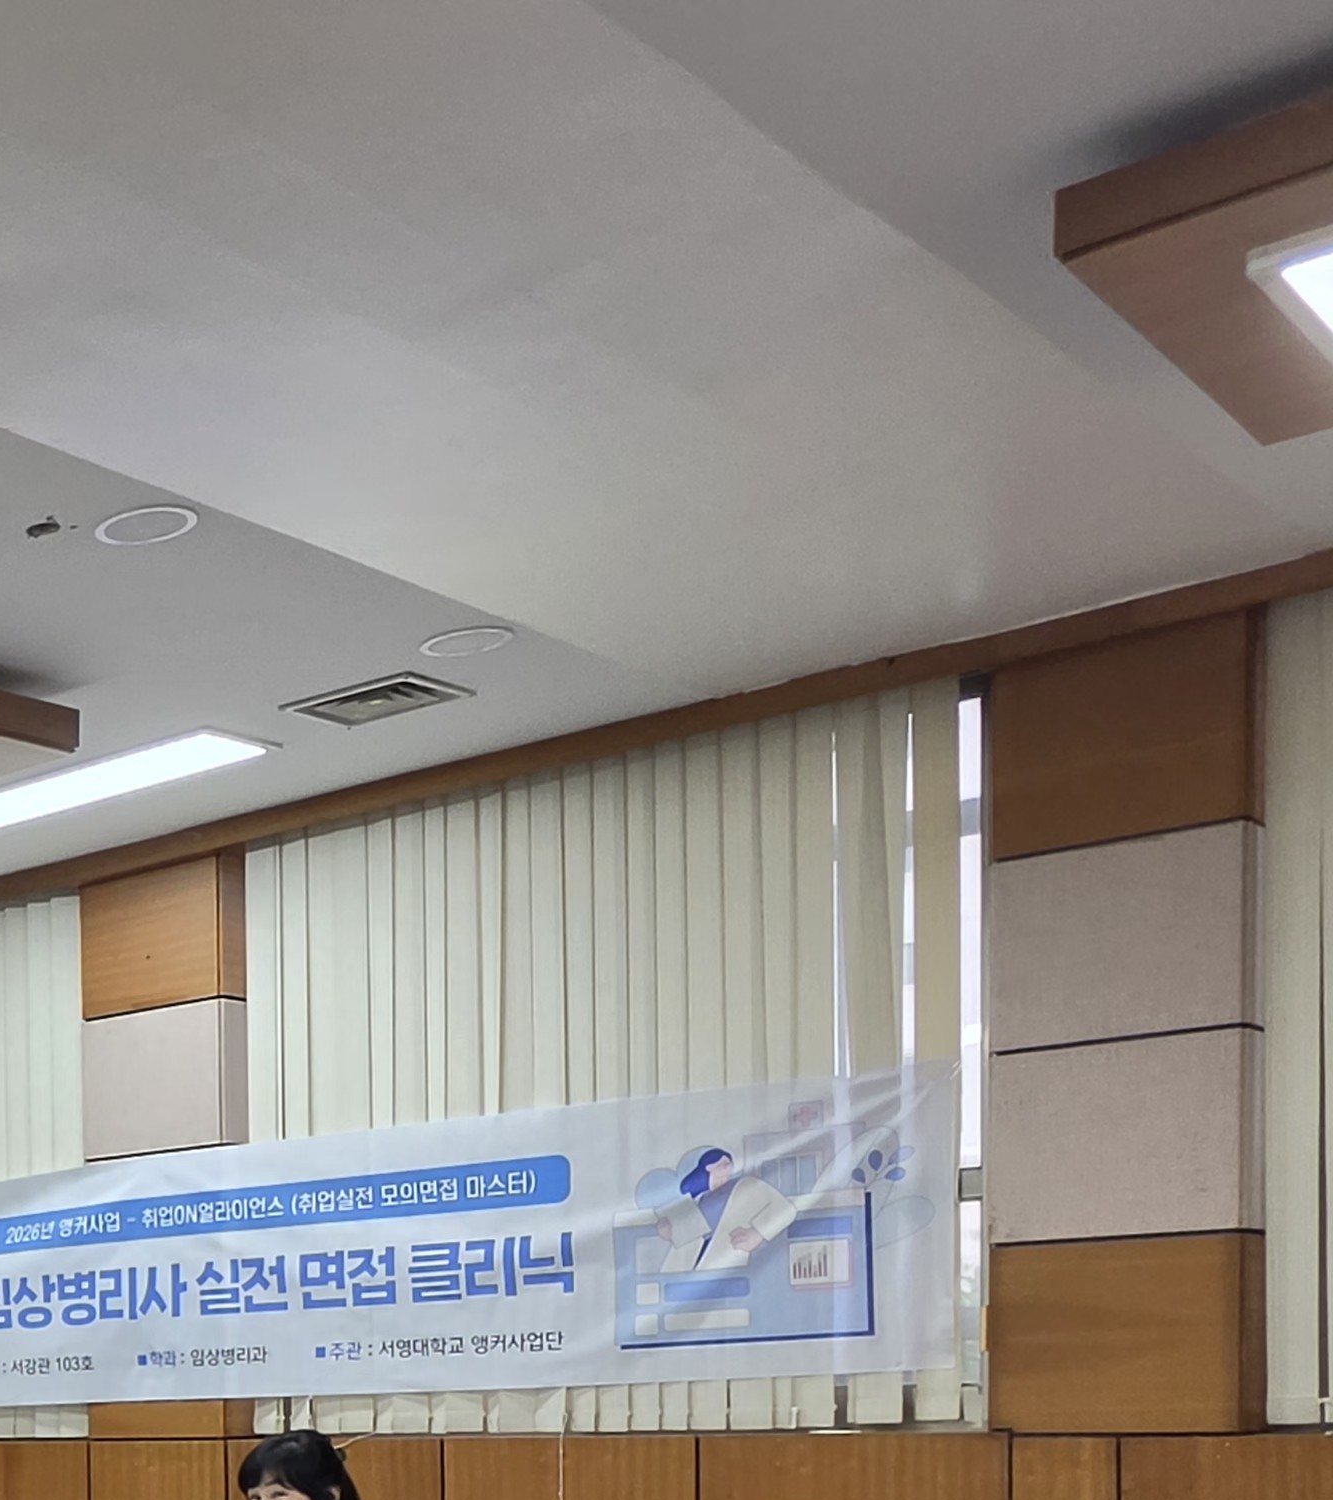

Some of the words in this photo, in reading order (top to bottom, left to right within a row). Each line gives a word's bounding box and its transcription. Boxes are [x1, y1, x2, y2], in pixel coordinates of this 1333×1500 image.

[5, 1221, 54, 1245] 2026년
[58, 1212, 121, 1238] 앵커사업
[290, 1186, 373, 1215] (취업실전
[380, 1178, 458, 1207] 모의면접
[465, 1170, 536, 1199] 마스터)
[196, 1255, 289, 1316] 실전
[299, 1246, 397, 1310] 면접
[408, 1232, 575, 1303] 클리닉
[149, 1350, 177, 1368] 학과
[190, 1345, 268, 1367] 임상병리과
[330, 1341, 362, 1361] 주관
[378, 1336, 465, 1359] 서영대학교
[470, 1331, 564, 1355] 앵커사업단
[10, 1358, 51, 1375] 서강관
[55, 1355, 95, 1372] 103호
